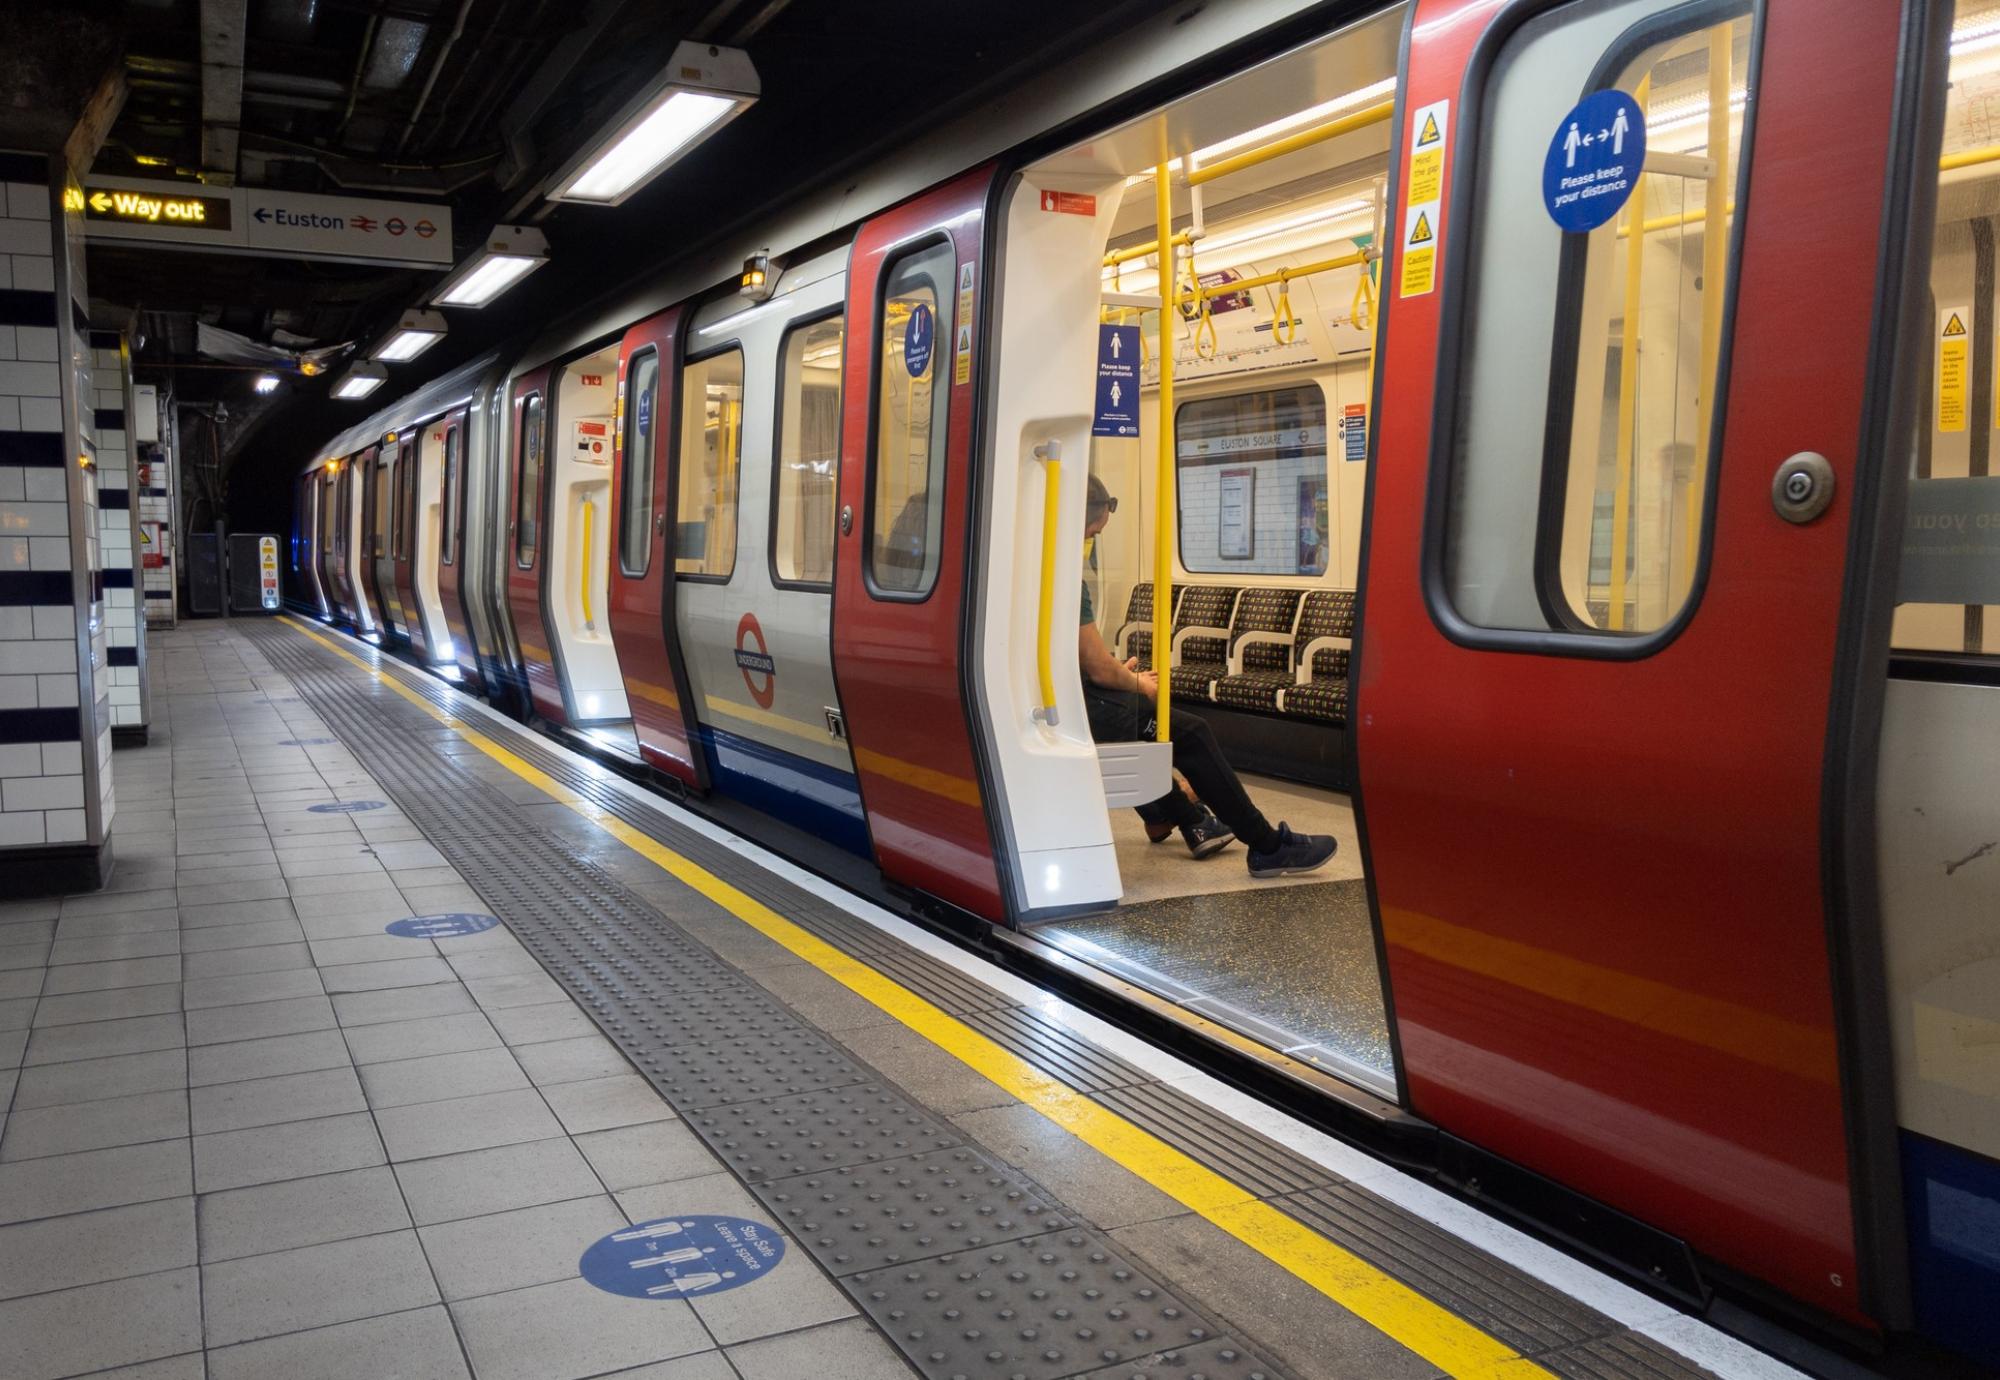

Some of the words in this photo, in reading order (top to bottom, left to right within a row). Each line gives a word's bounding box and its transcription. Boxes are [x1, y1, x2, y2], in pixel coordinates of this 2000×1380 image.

[1561, 173, 1595, 189] Please
[1597, 165, 1624, 180] keep
[1555, 191, 1580, 208] your
[1581, 179, 1627, 199] distance
[114, 193, 162, 220] Way
[164, 201, 205, 220] out
[275, 209, 345, 230] Euston
[1221, 437, 1250, 450] EUSTON
[1253, 433, 1282, 447] SQUARE
[736, 653, 773, 671] UNDERGROUND
[714, 1221, 738, 1243] Leave
[735, 1247, 761, 1270] space
[740, 1225, 761, 1241] Stay
[754, 1240, 776, 1257] Safe
